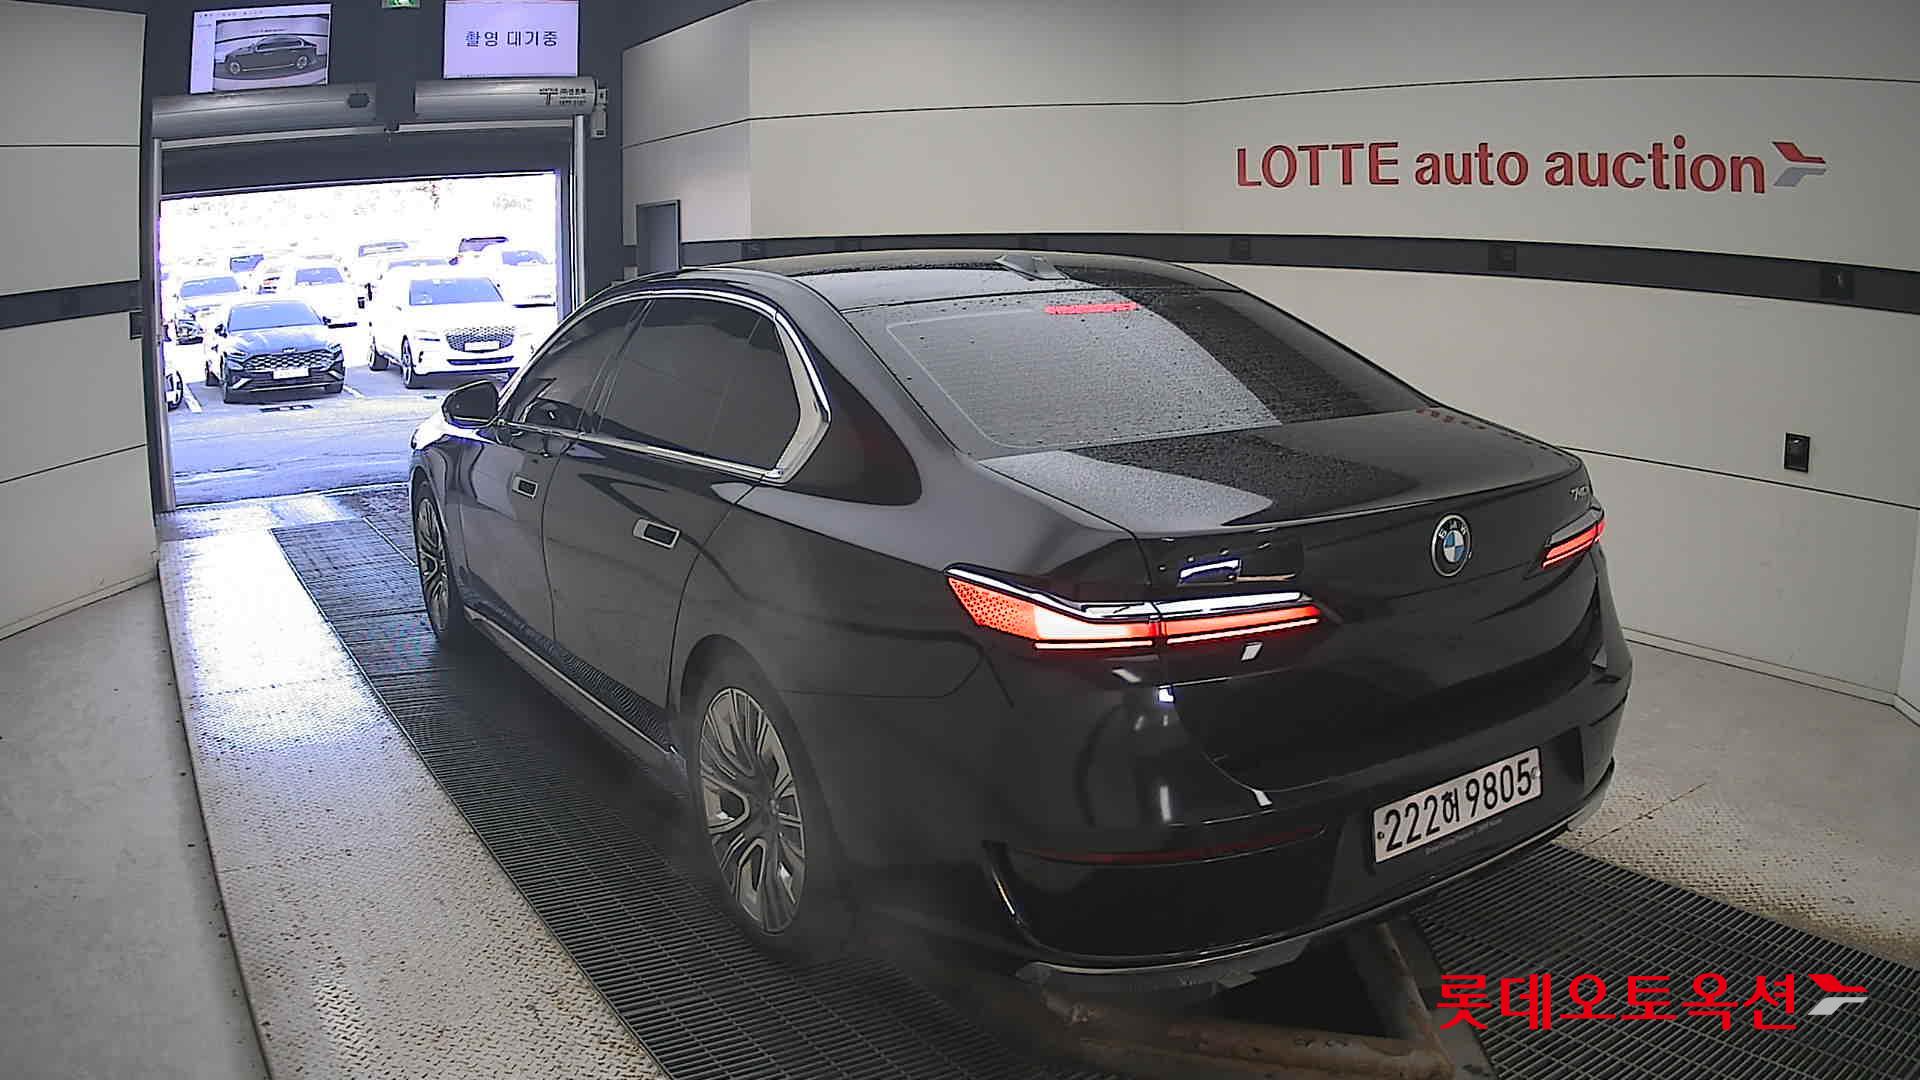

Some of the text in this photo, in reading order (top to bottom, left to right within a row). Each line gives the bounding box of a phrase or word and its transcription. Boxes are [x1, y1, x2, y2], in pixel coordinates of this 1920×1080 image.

[506, 31, 558, 47] 대기중
[1236, 134, 1766, 194] LOTTE auto auction
